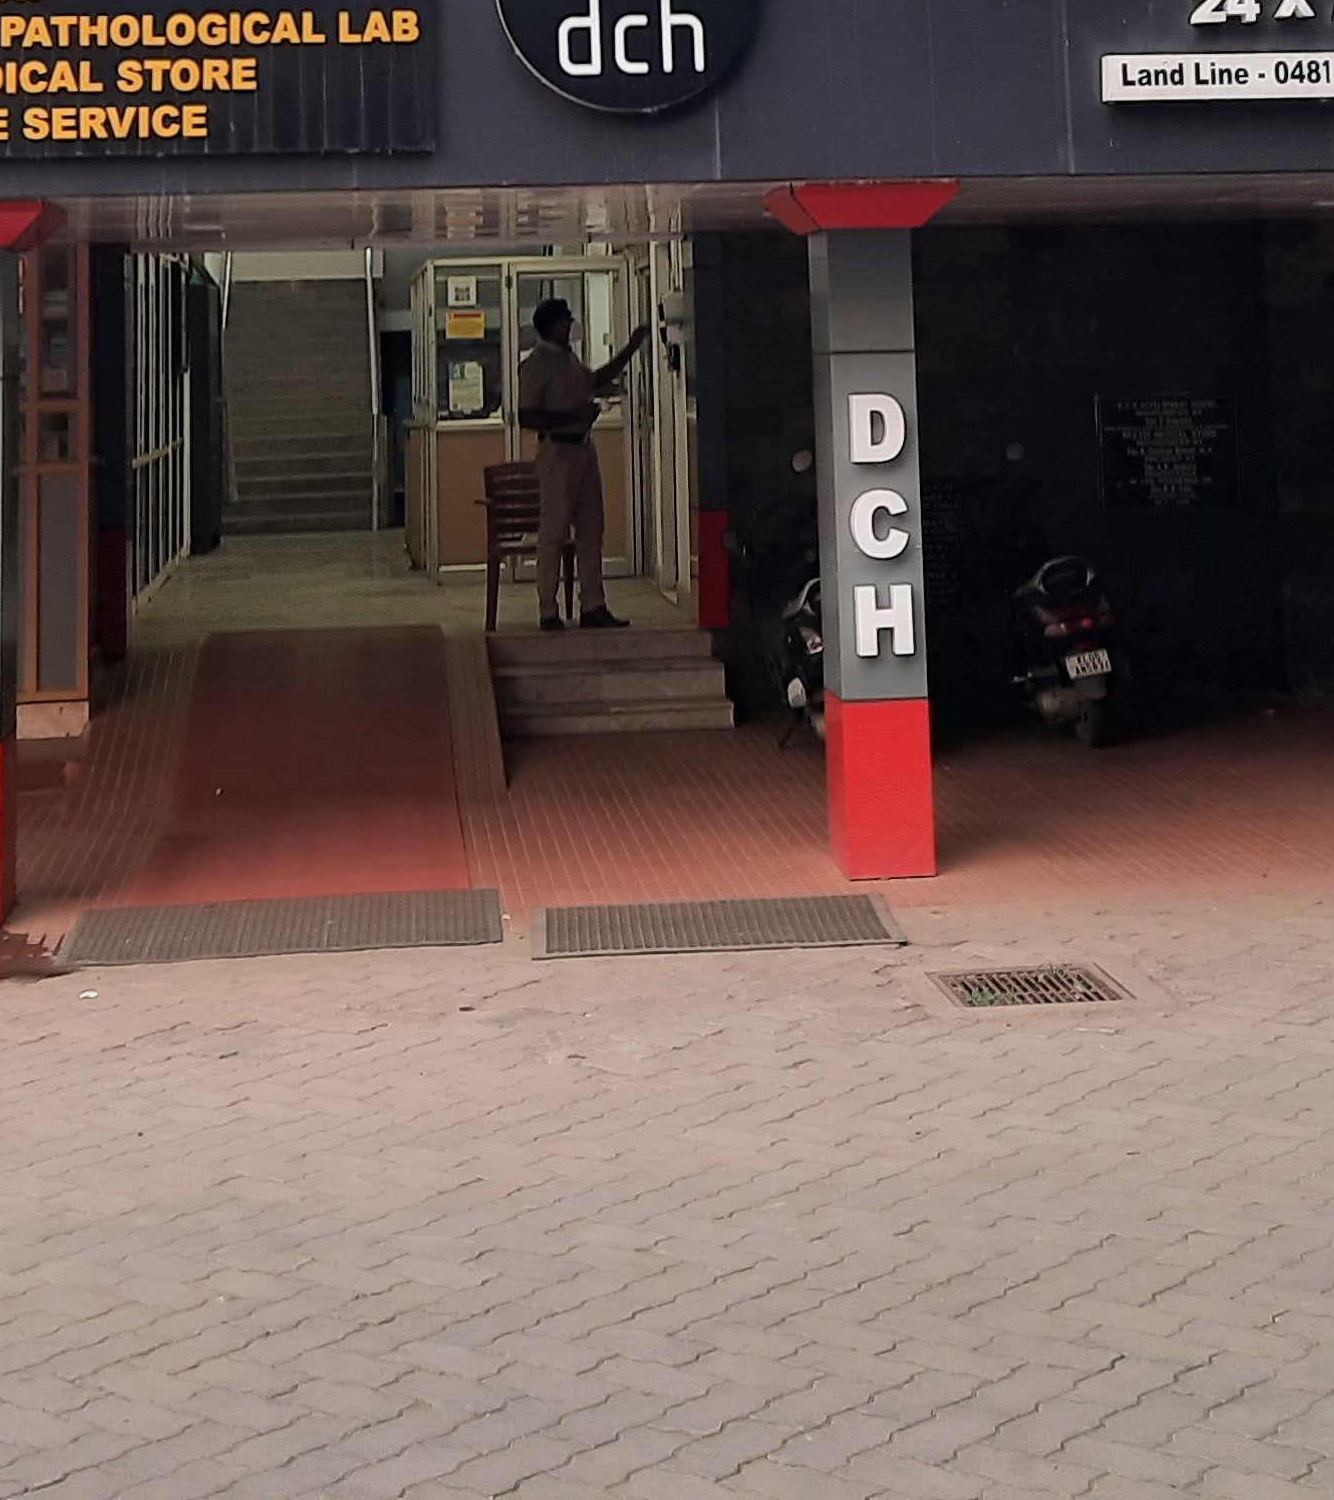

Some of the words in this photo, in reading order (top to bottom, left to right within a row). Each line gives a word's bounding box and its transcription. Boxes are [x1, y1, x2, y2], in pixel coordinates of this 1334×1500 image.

[0, 11, 326, 47] PATHOLOGICAL
[338, 10, 420, 43] LAB
[117, 58, 257, 92] STORE
[1121, 61, 1184, 87] Land
[1194, 62, 1249, 86] Line
[1274, 60, 1331, 85] 0481
[23, 105, 208, 140] SERVICE
